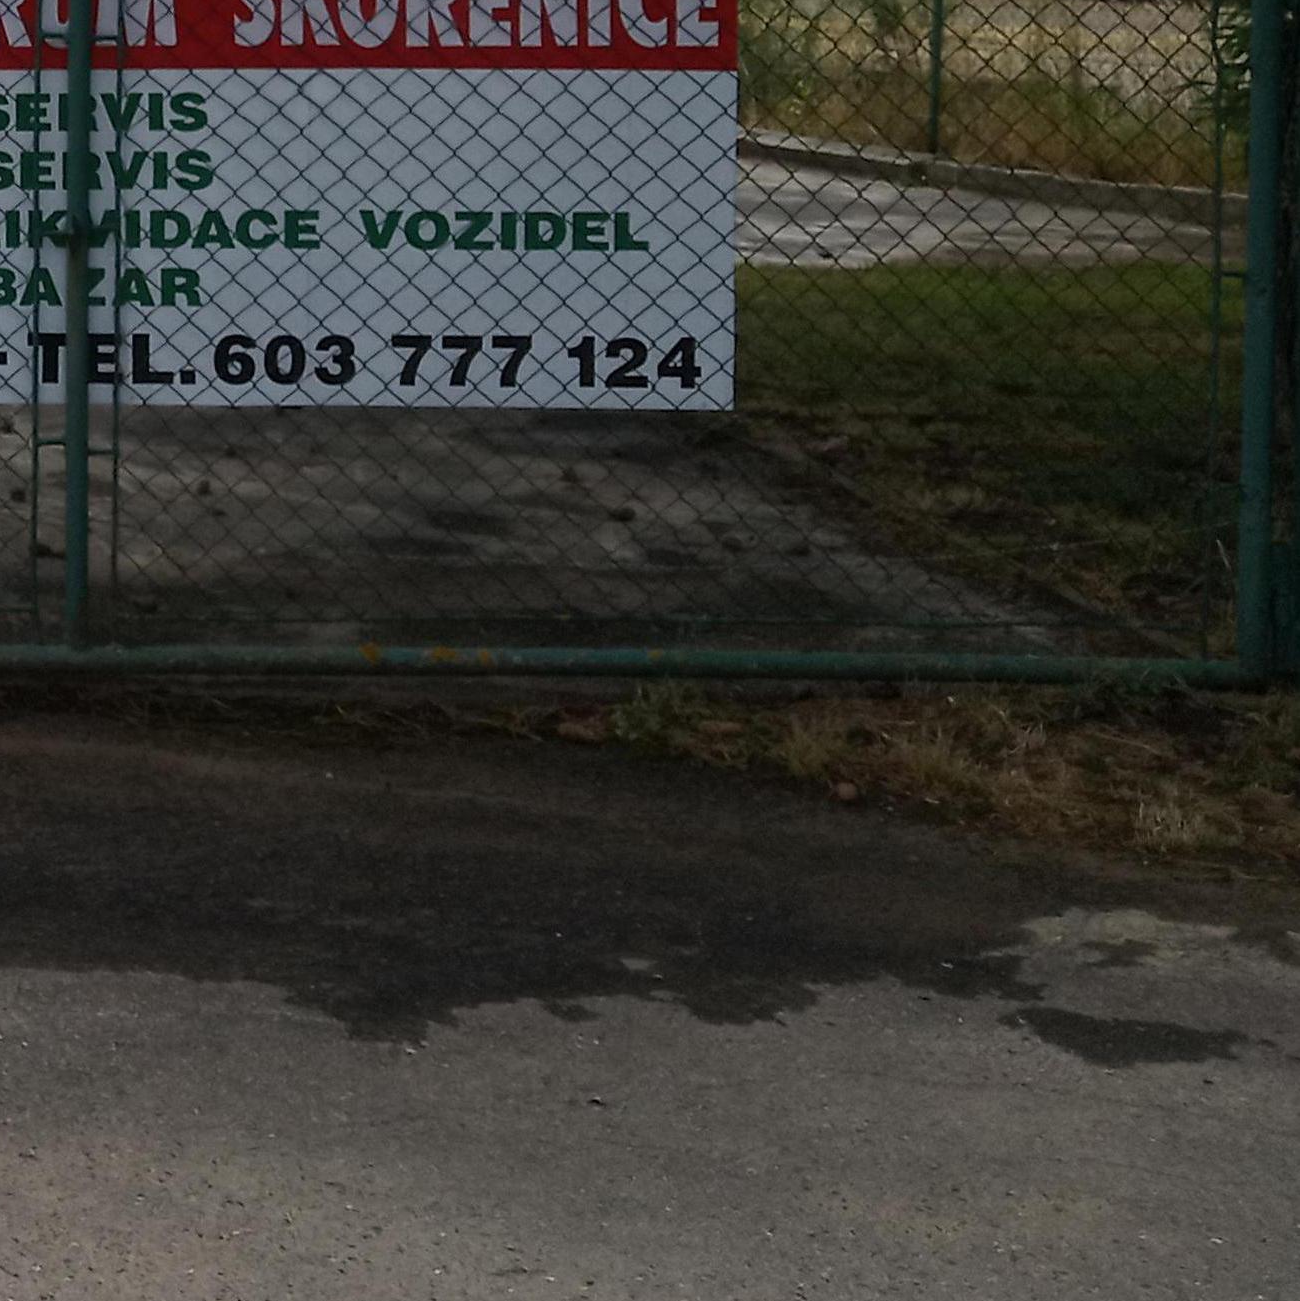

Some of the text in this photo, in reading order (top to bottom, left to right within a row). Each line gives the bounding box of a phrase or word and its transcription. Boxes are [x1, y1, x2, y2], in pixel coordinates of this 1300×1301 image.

[359, 211, 650, 252] VOZIDEL
[390, 334, 534, 388] 777
[567, 336, 702, 389] 124
